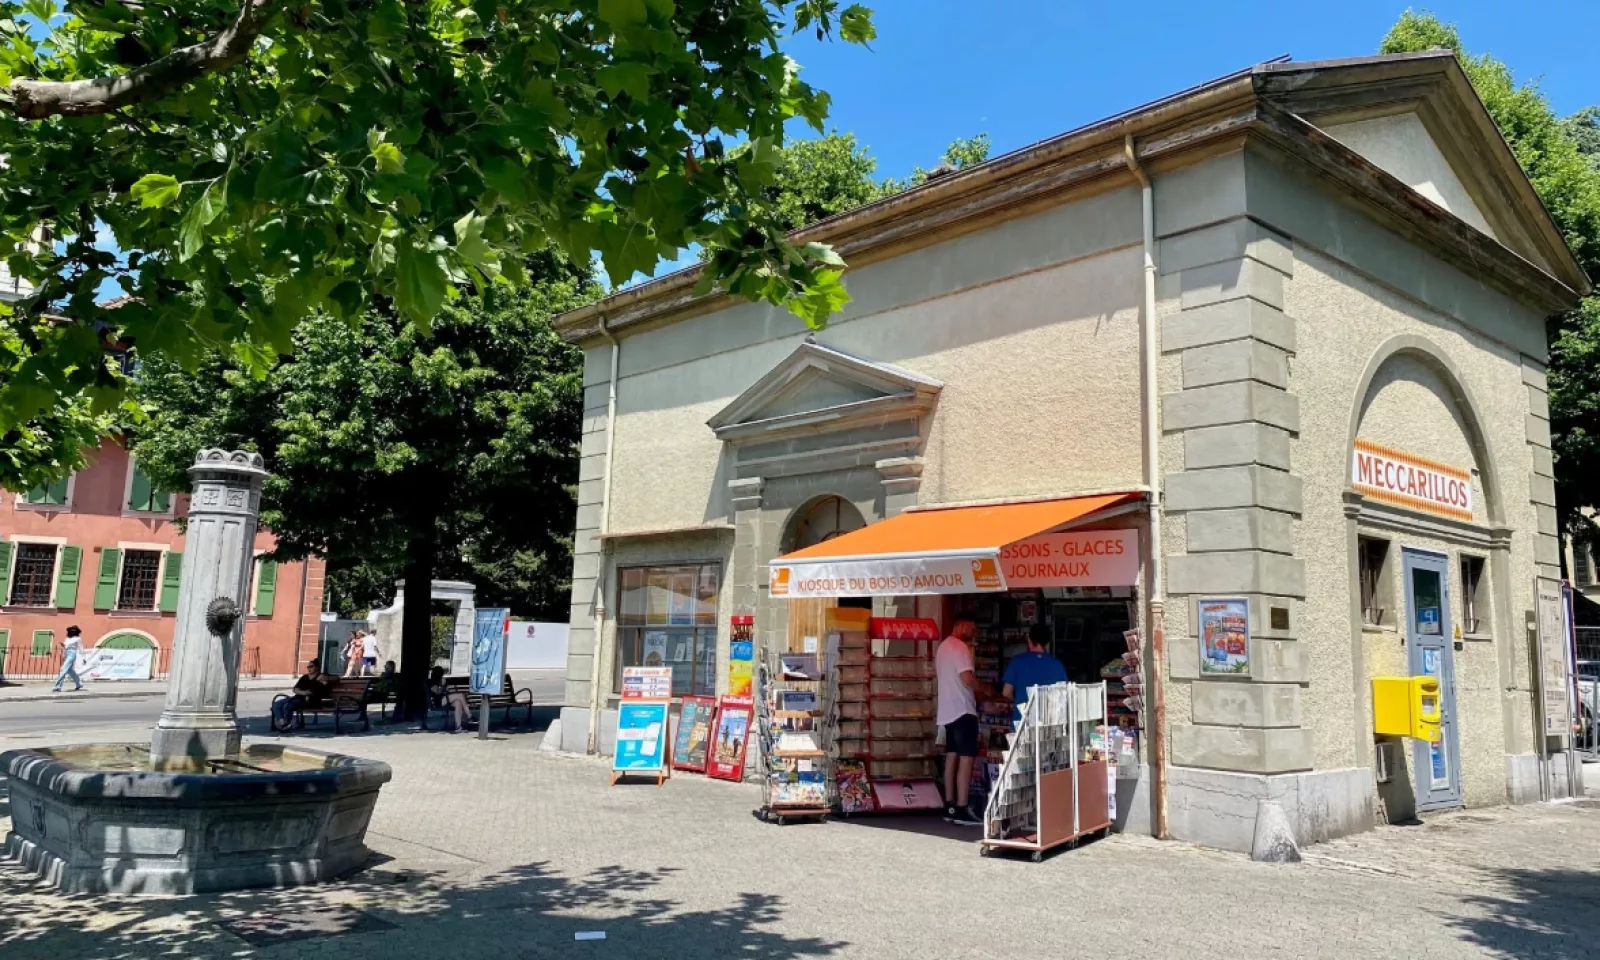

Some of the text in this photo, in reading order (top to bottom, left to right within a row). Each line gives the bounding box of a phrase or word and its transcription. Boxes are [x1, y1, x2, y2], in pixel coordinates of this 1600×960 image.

[1357, 453, 1468, 508] MECCARILLOS
[1063, 540, 1124, 557] GLACES
[1009, 562, 1090, 578] JOURNAUX
[798, 578, 845, 592] KIOSQUE
[849, 577, 865, 590] DU
[869, 576, 896, 590] BOIS
[900, 573, 964, 588] D'AMOUR
